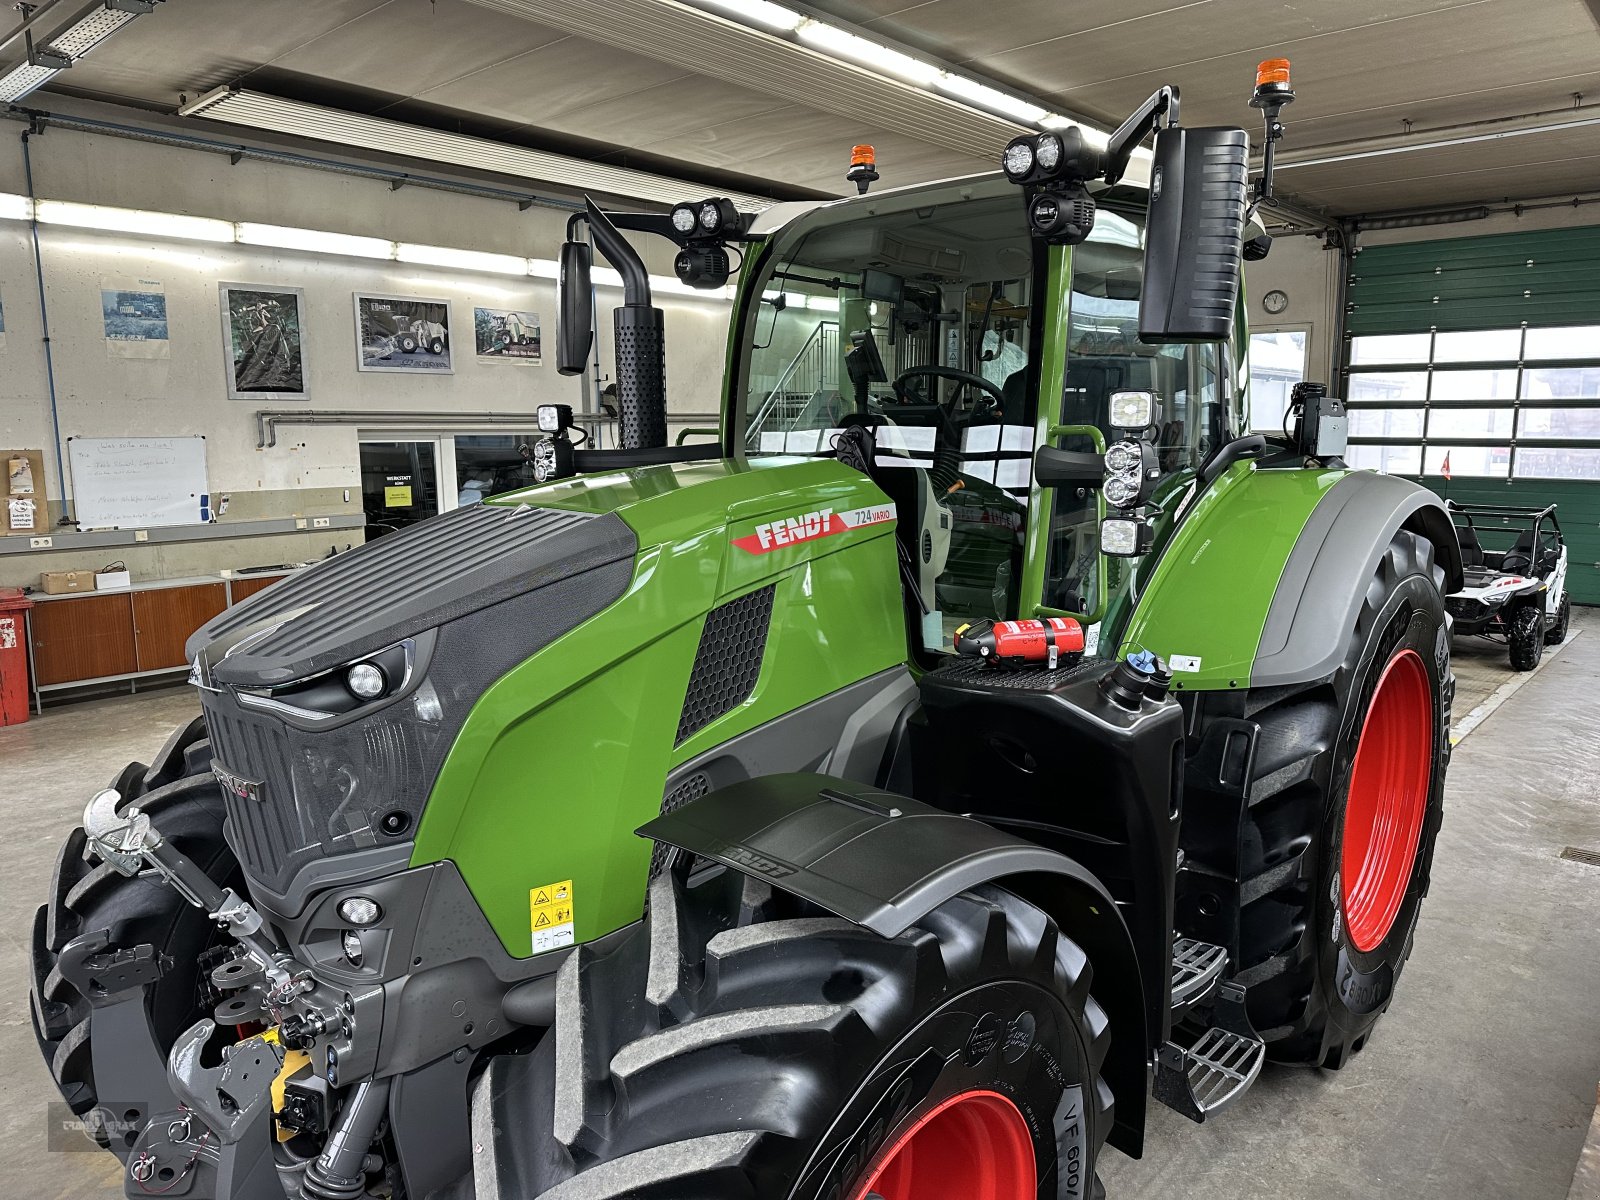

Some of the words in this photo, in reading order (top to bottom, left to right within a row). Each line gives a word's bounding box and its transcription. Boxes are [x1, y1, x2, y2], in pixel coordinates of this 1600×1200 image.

[755, 507, 833, 549] FENDT
[855, 509, 872, 525] 724
[872, 509, 890, 521] VARIO
[1063, 1103, 1079, 1138] VF
